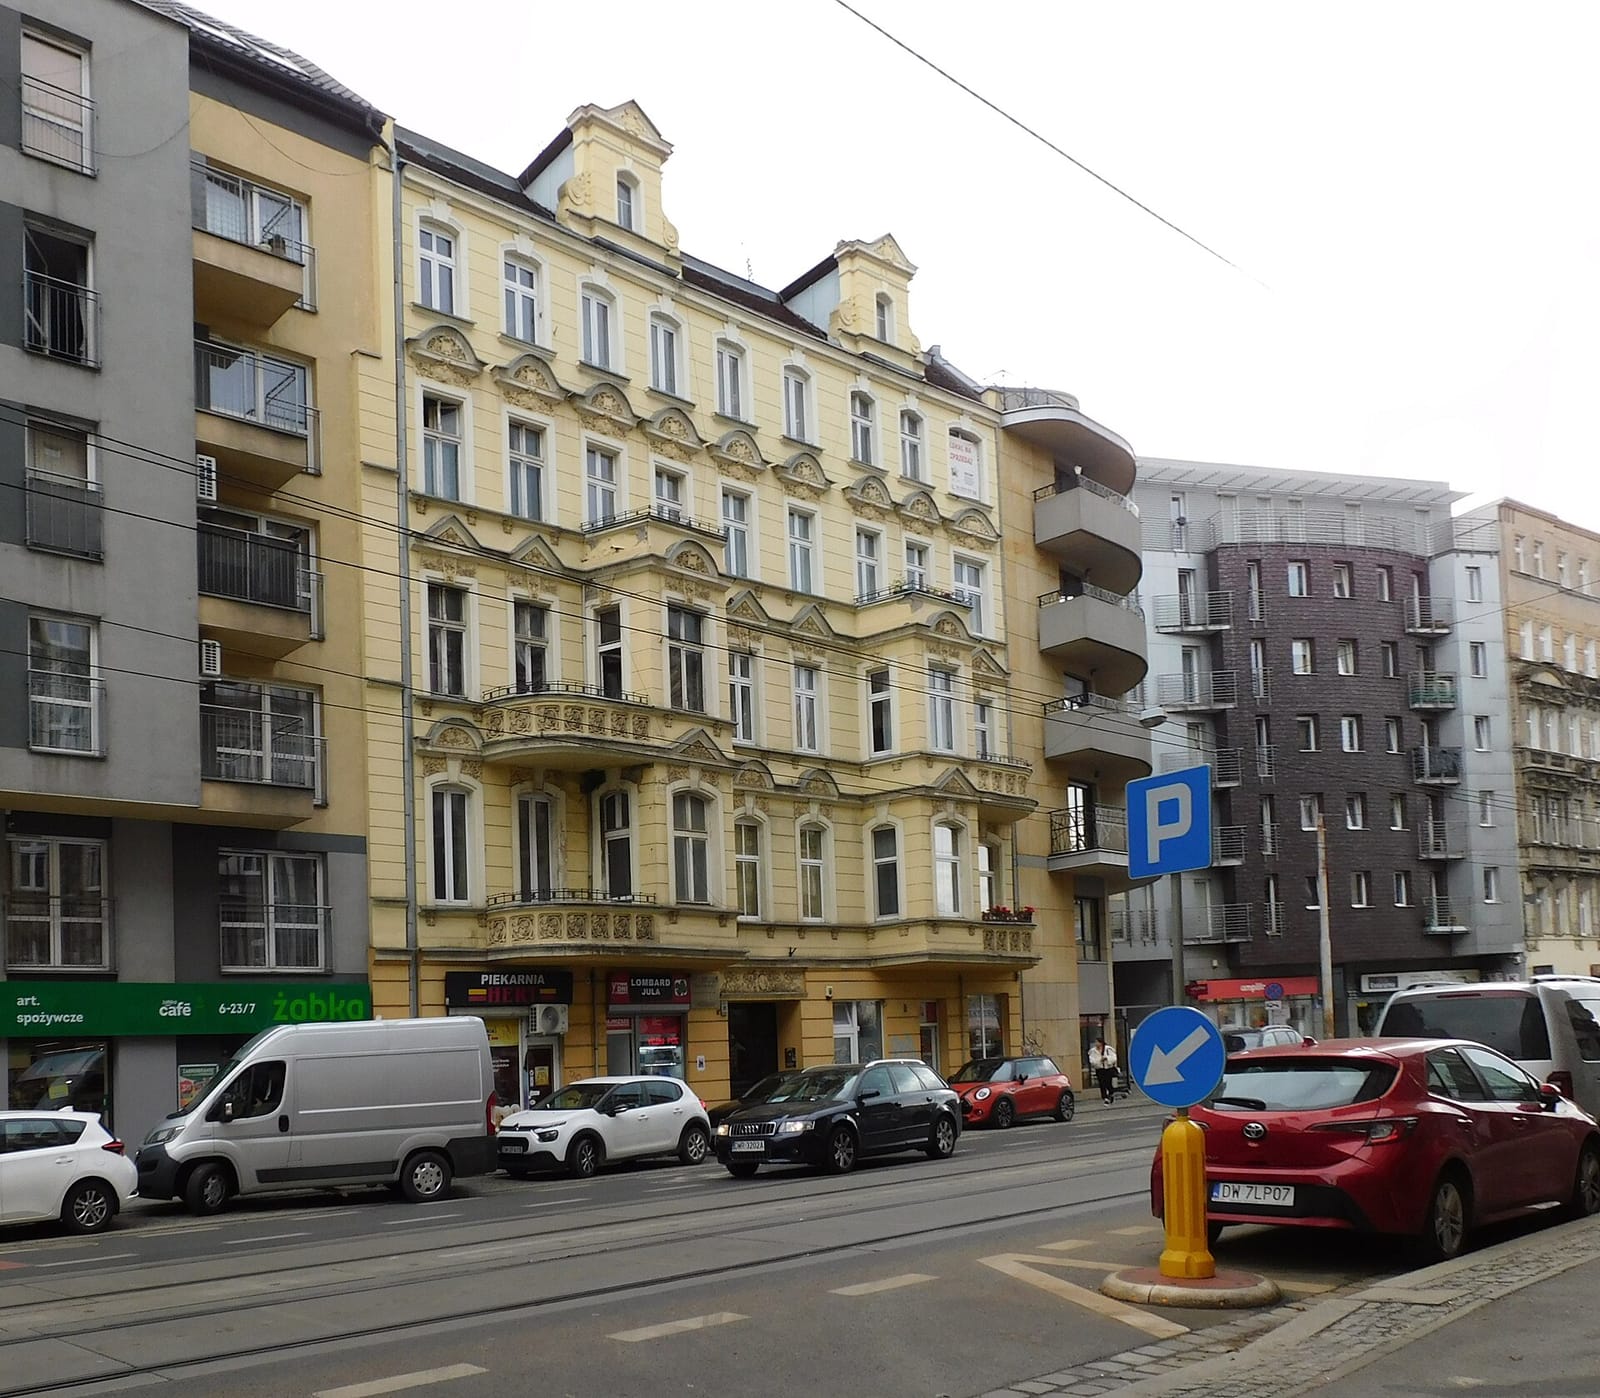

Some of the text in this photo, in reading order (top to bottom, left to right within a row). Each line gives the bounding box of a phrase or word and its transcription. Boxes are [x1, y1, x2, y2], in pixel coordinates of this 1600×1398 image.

[1145, 782, 1192, 864] P
[481, 974, 545, 985] PIEKARNIA
[630, 978, 671, 987] LOMBARD
[641, 988, 661, 996] JULA
[16, 995, 41, 1006] art.
[273, 992, 364, 1020] żabka
[218, 1003, 256, 1015] 6-23/7
[16, 1012, 84, 1026] spożywcze
[1222, 1184, 1290, 1201] DW 7LP07
